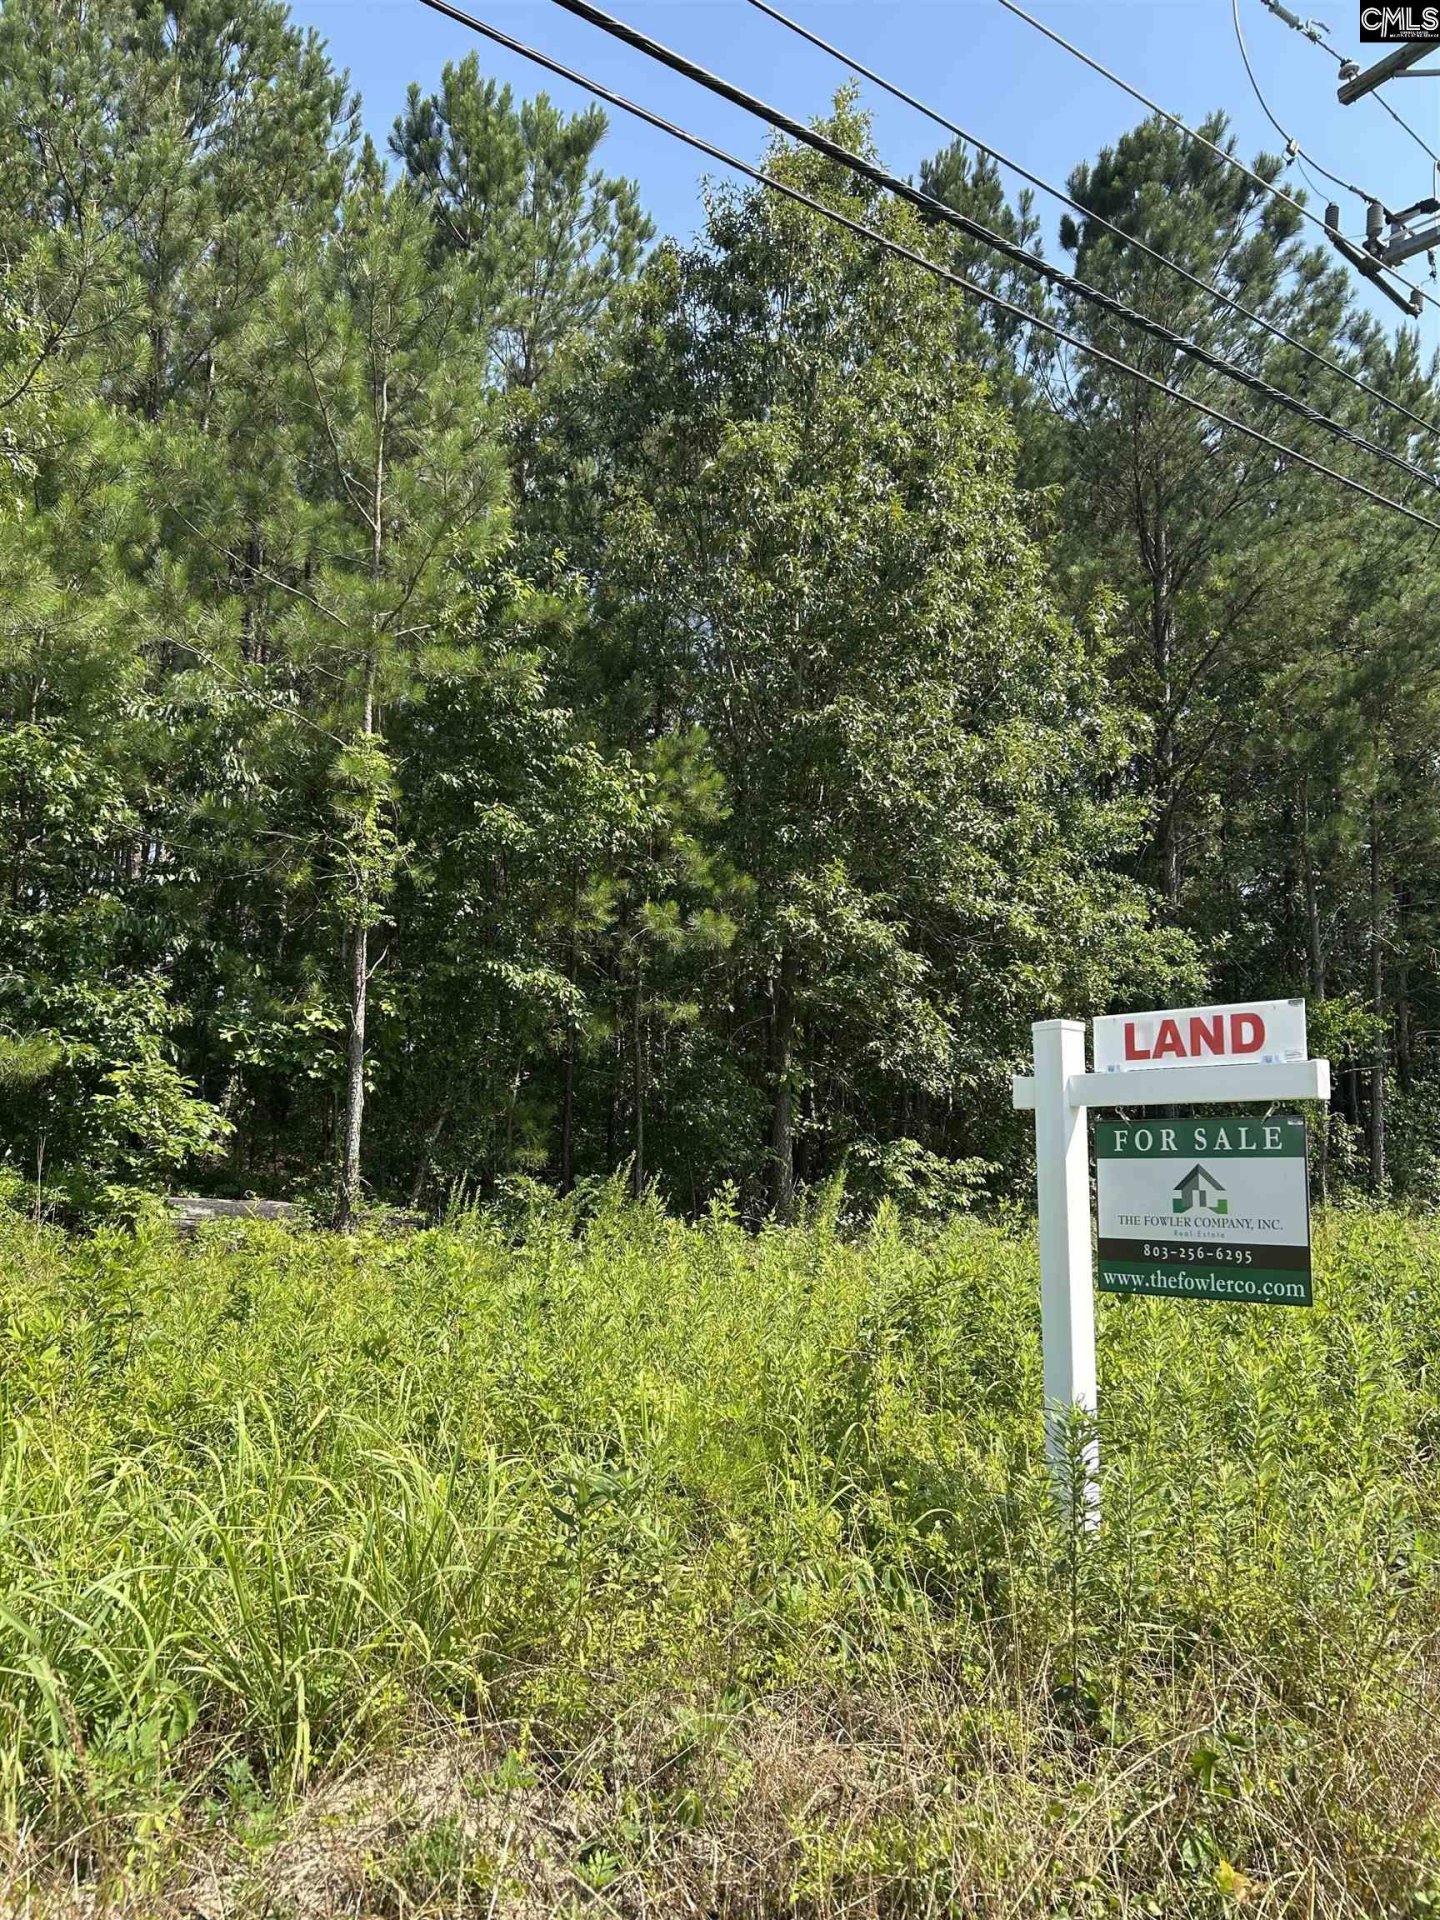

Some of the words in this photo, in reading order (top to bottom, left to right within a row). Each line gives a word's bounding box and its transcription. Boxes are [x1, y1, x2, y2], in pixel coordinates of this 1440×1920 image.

[1124, 1012, 1266, 1061] LAND
[1114, 1128, 1178, 1151] FOR
[1194, 1126, 1282, 1151] SALE
[1118, 1215, 1141, 1226] THE
[1144, 1215, 1192, 1228] FOWLER
[1194, 1217, 1254, 1231] COMPANY,
[1257, 1219, 1283, 1231] INC.
[1174, 1229, 1195, 1237] Real
[1197, 1230, 1225, 1238] Estate
[1143, 1244, 1253, 1264] 803-256-6295
[1103, 1269, 1306, 1298] www.thefowlerco.com
